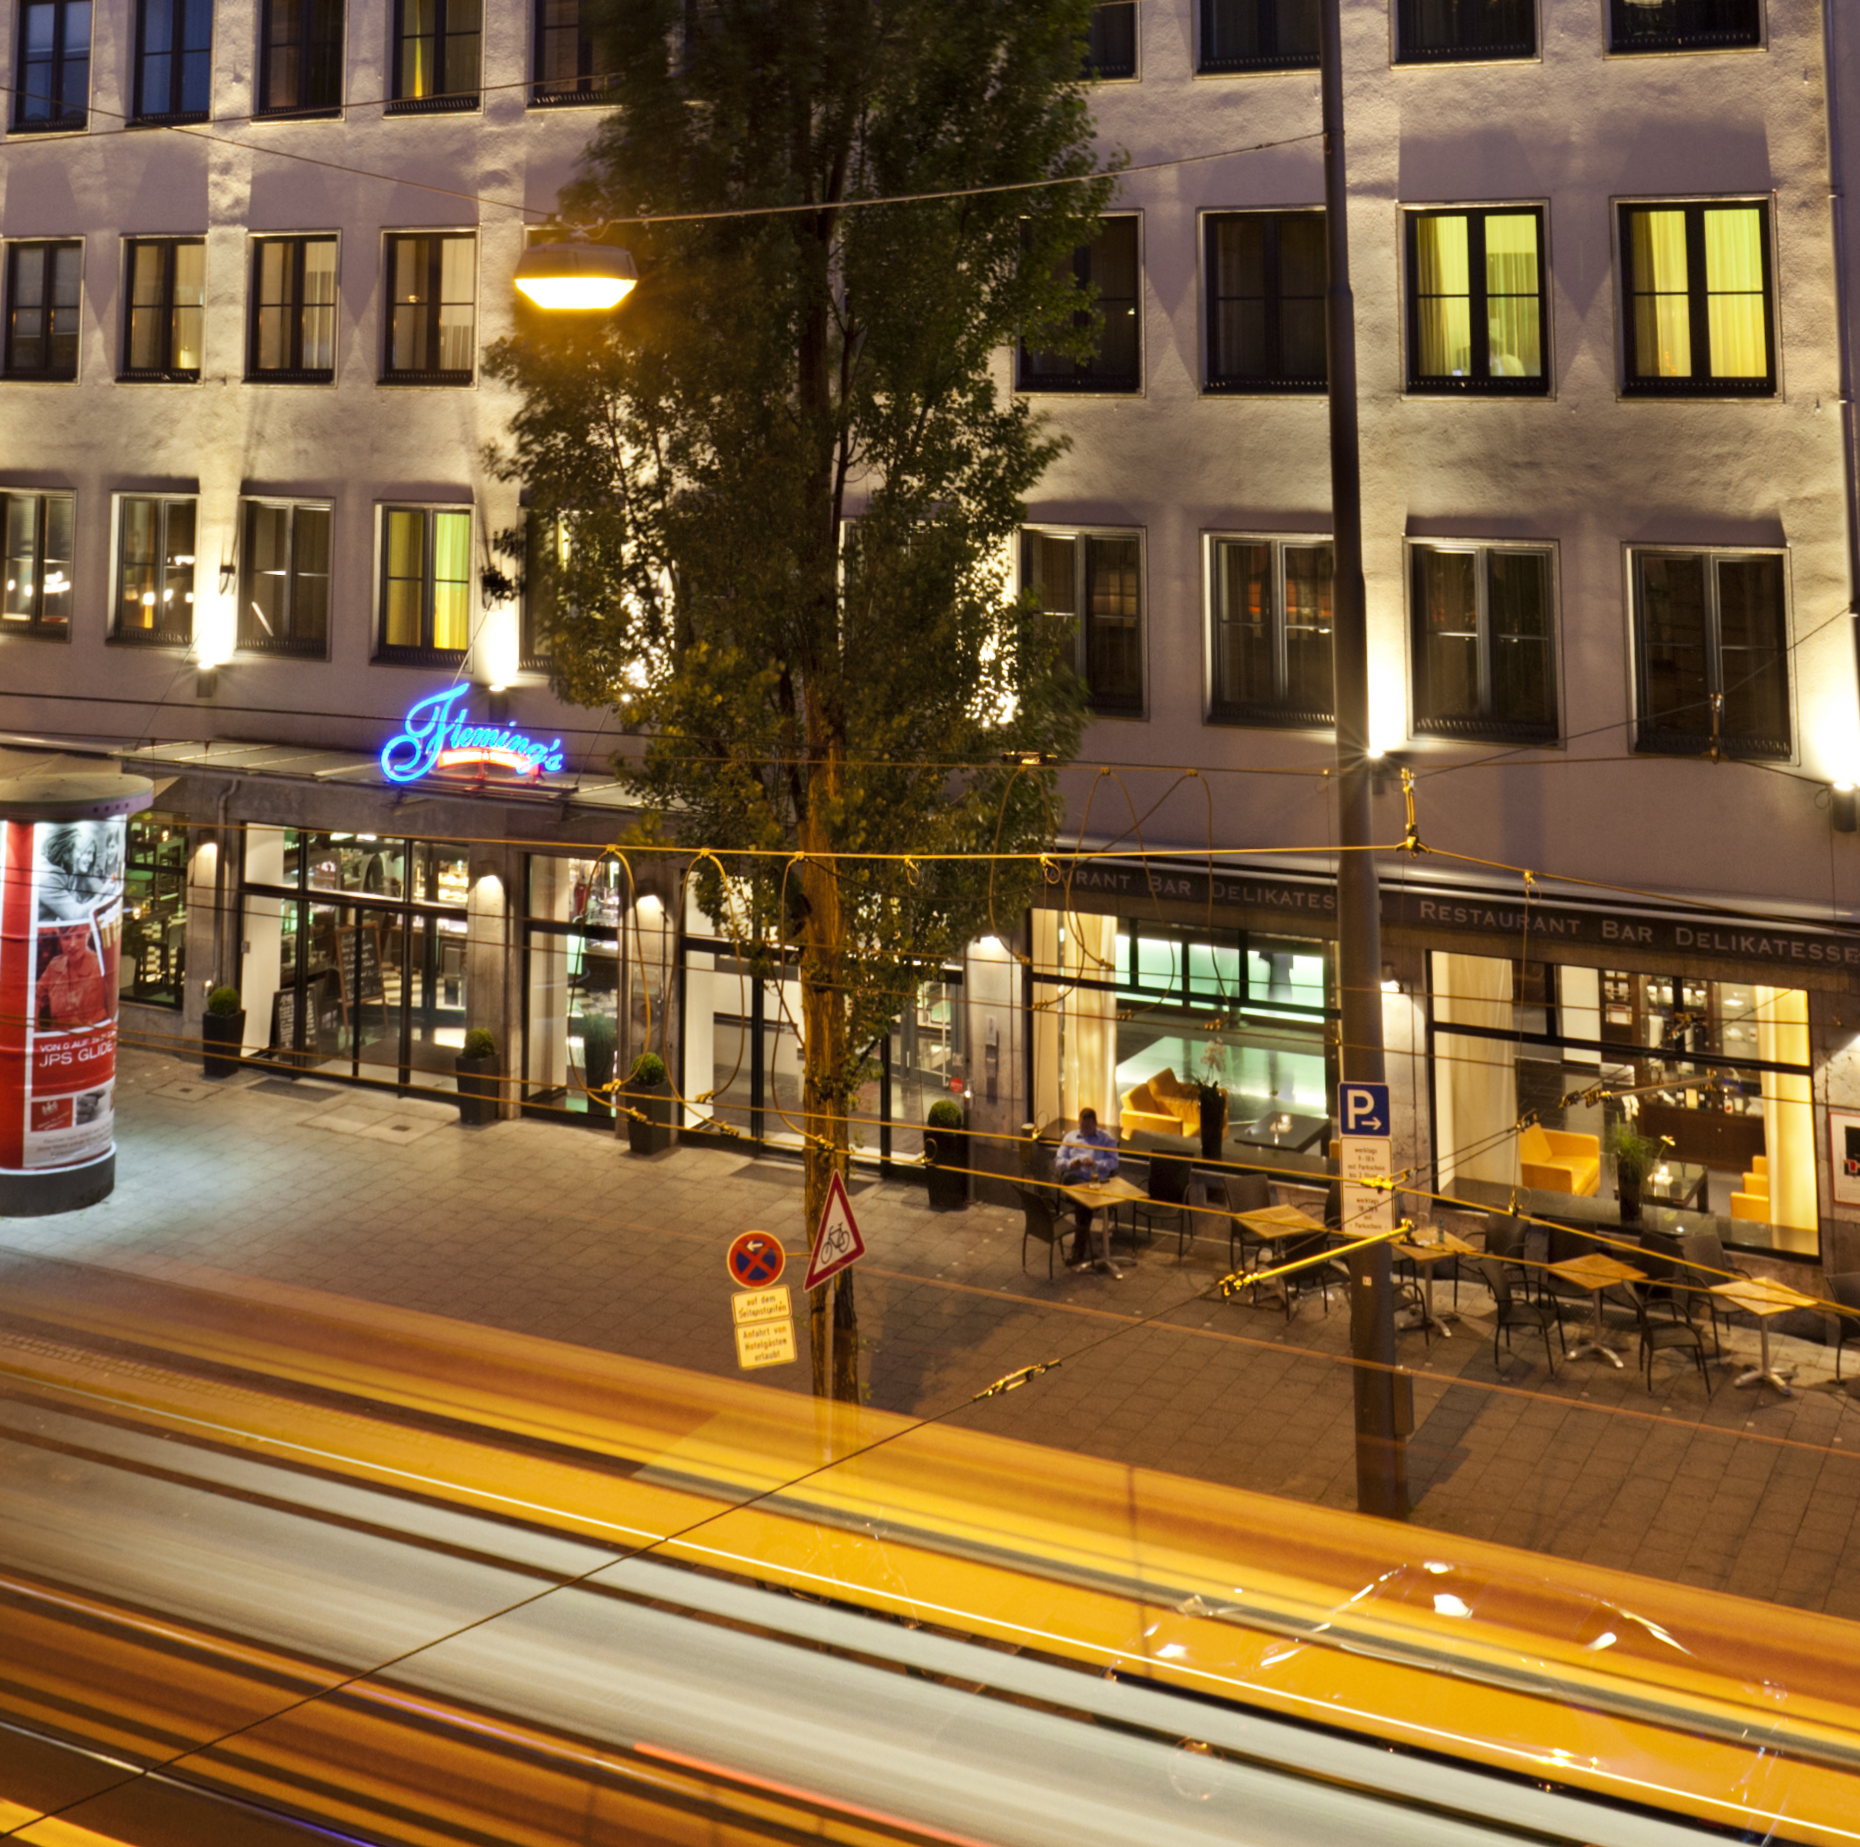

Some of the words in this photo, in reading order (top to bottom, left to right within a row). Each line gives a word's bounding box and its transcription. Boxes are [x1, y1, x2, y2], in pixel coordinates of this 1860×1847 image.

[381, 682, 564, 783] Fleming's
[1149, 876, 1190, 896] BAR
[1419, 900, 1580, 935] RESTAURANT
[1601, 919, 1653, 944] BAR
[39, 1051, 73, 1067] JPS
[761, 1295, 776, 1304] dem
[774, 1326, 787, 1334] von
[754, 1350, 781, 1361] erlaubt
